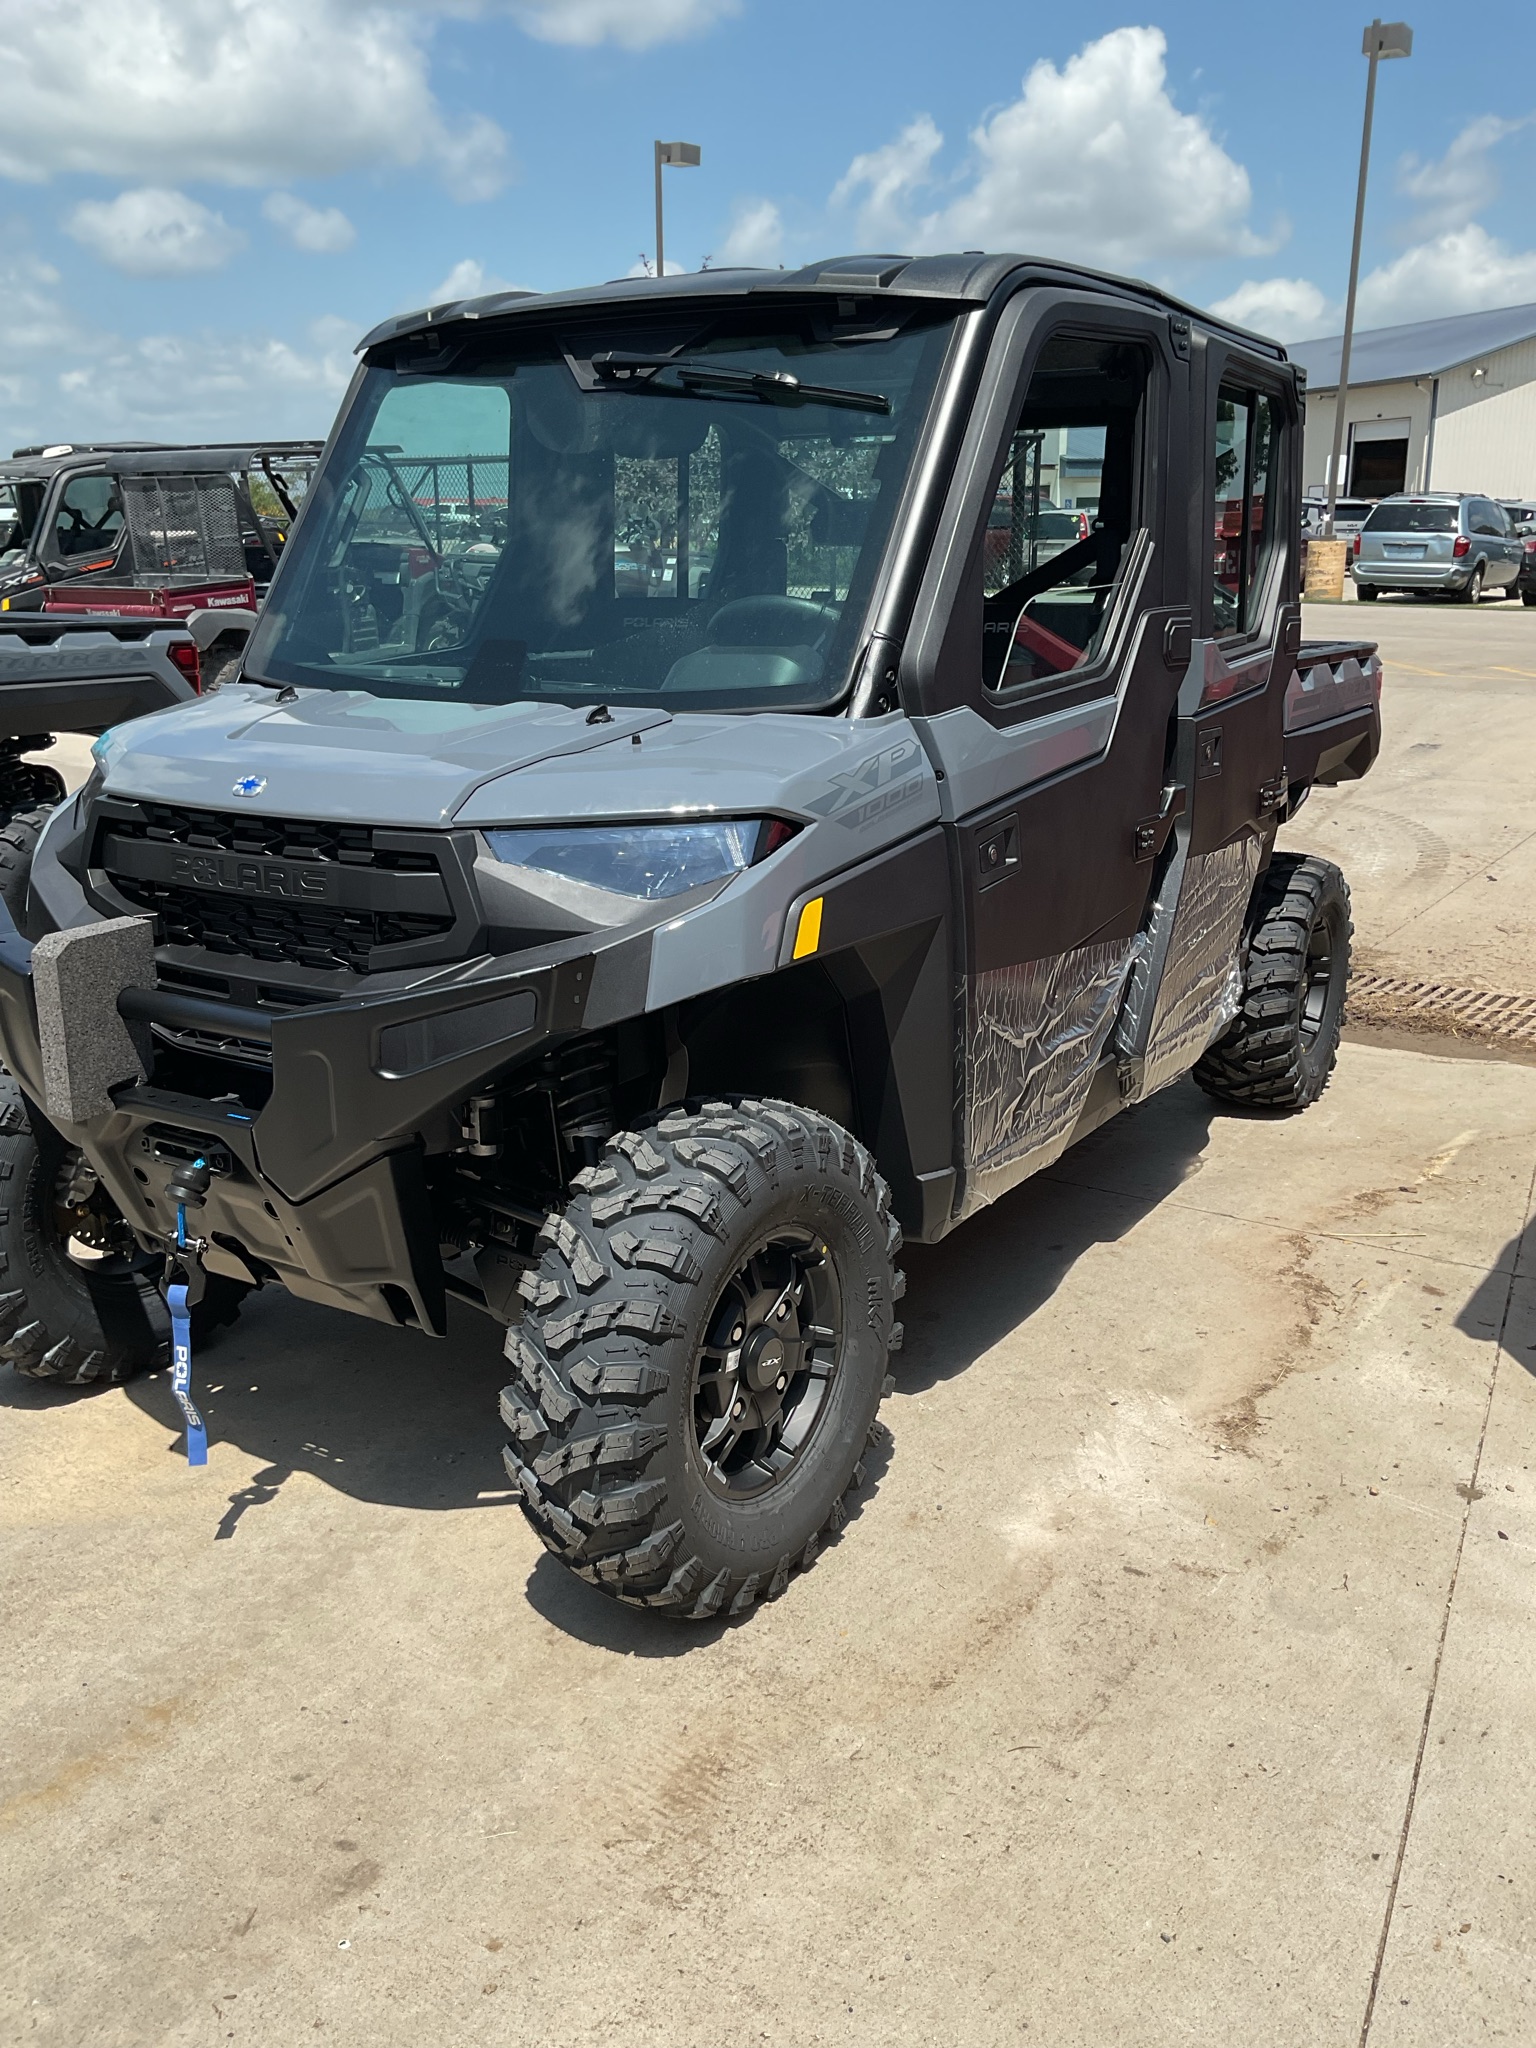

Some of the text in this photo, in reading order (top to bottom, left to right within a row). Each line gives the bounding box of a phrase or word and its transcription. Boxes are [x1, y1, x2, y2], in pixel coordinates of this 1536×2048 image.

[207, 593, 250, 608] Kawasaki
[623, 617, 690, 628] POLARIS
[826, 738, 919, 816] XP
[856, 772, 924, 824] 1000
[170, 852, 330, 900] POLARIS
[799, 1183, 876, 1254] X-TERRAIN
[174, 1345, 202, 1427] POLARIS
